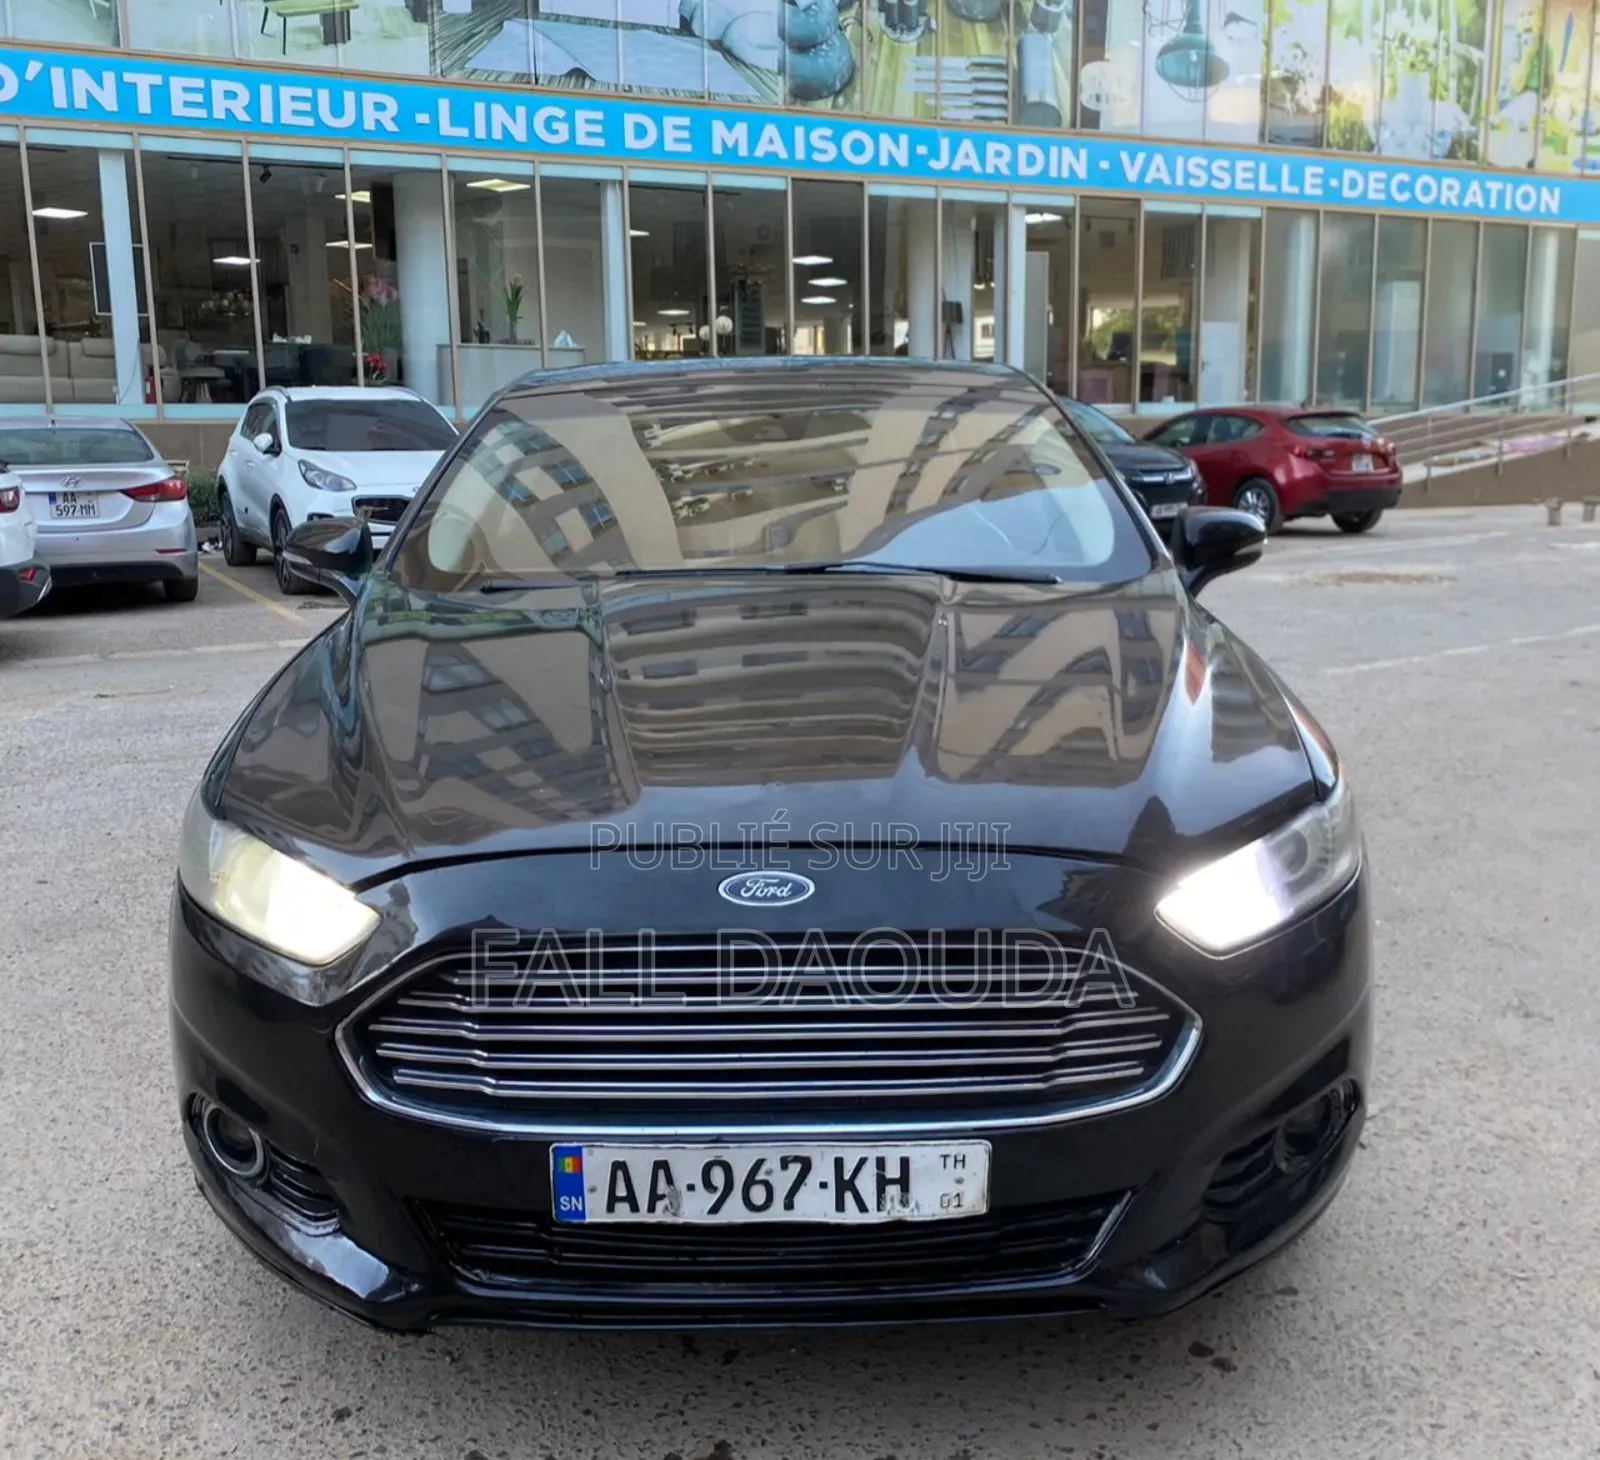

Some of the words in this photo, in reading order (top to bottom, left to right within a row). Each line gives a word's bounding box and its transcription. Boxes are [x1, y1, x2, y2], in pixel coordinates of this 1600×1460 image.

[624, 113, 693, 152] DE
[740, 878, 793, 898] Ford
[939, 1153, 966, 1170] TH
[559, 1195, 583, 1212] SN
